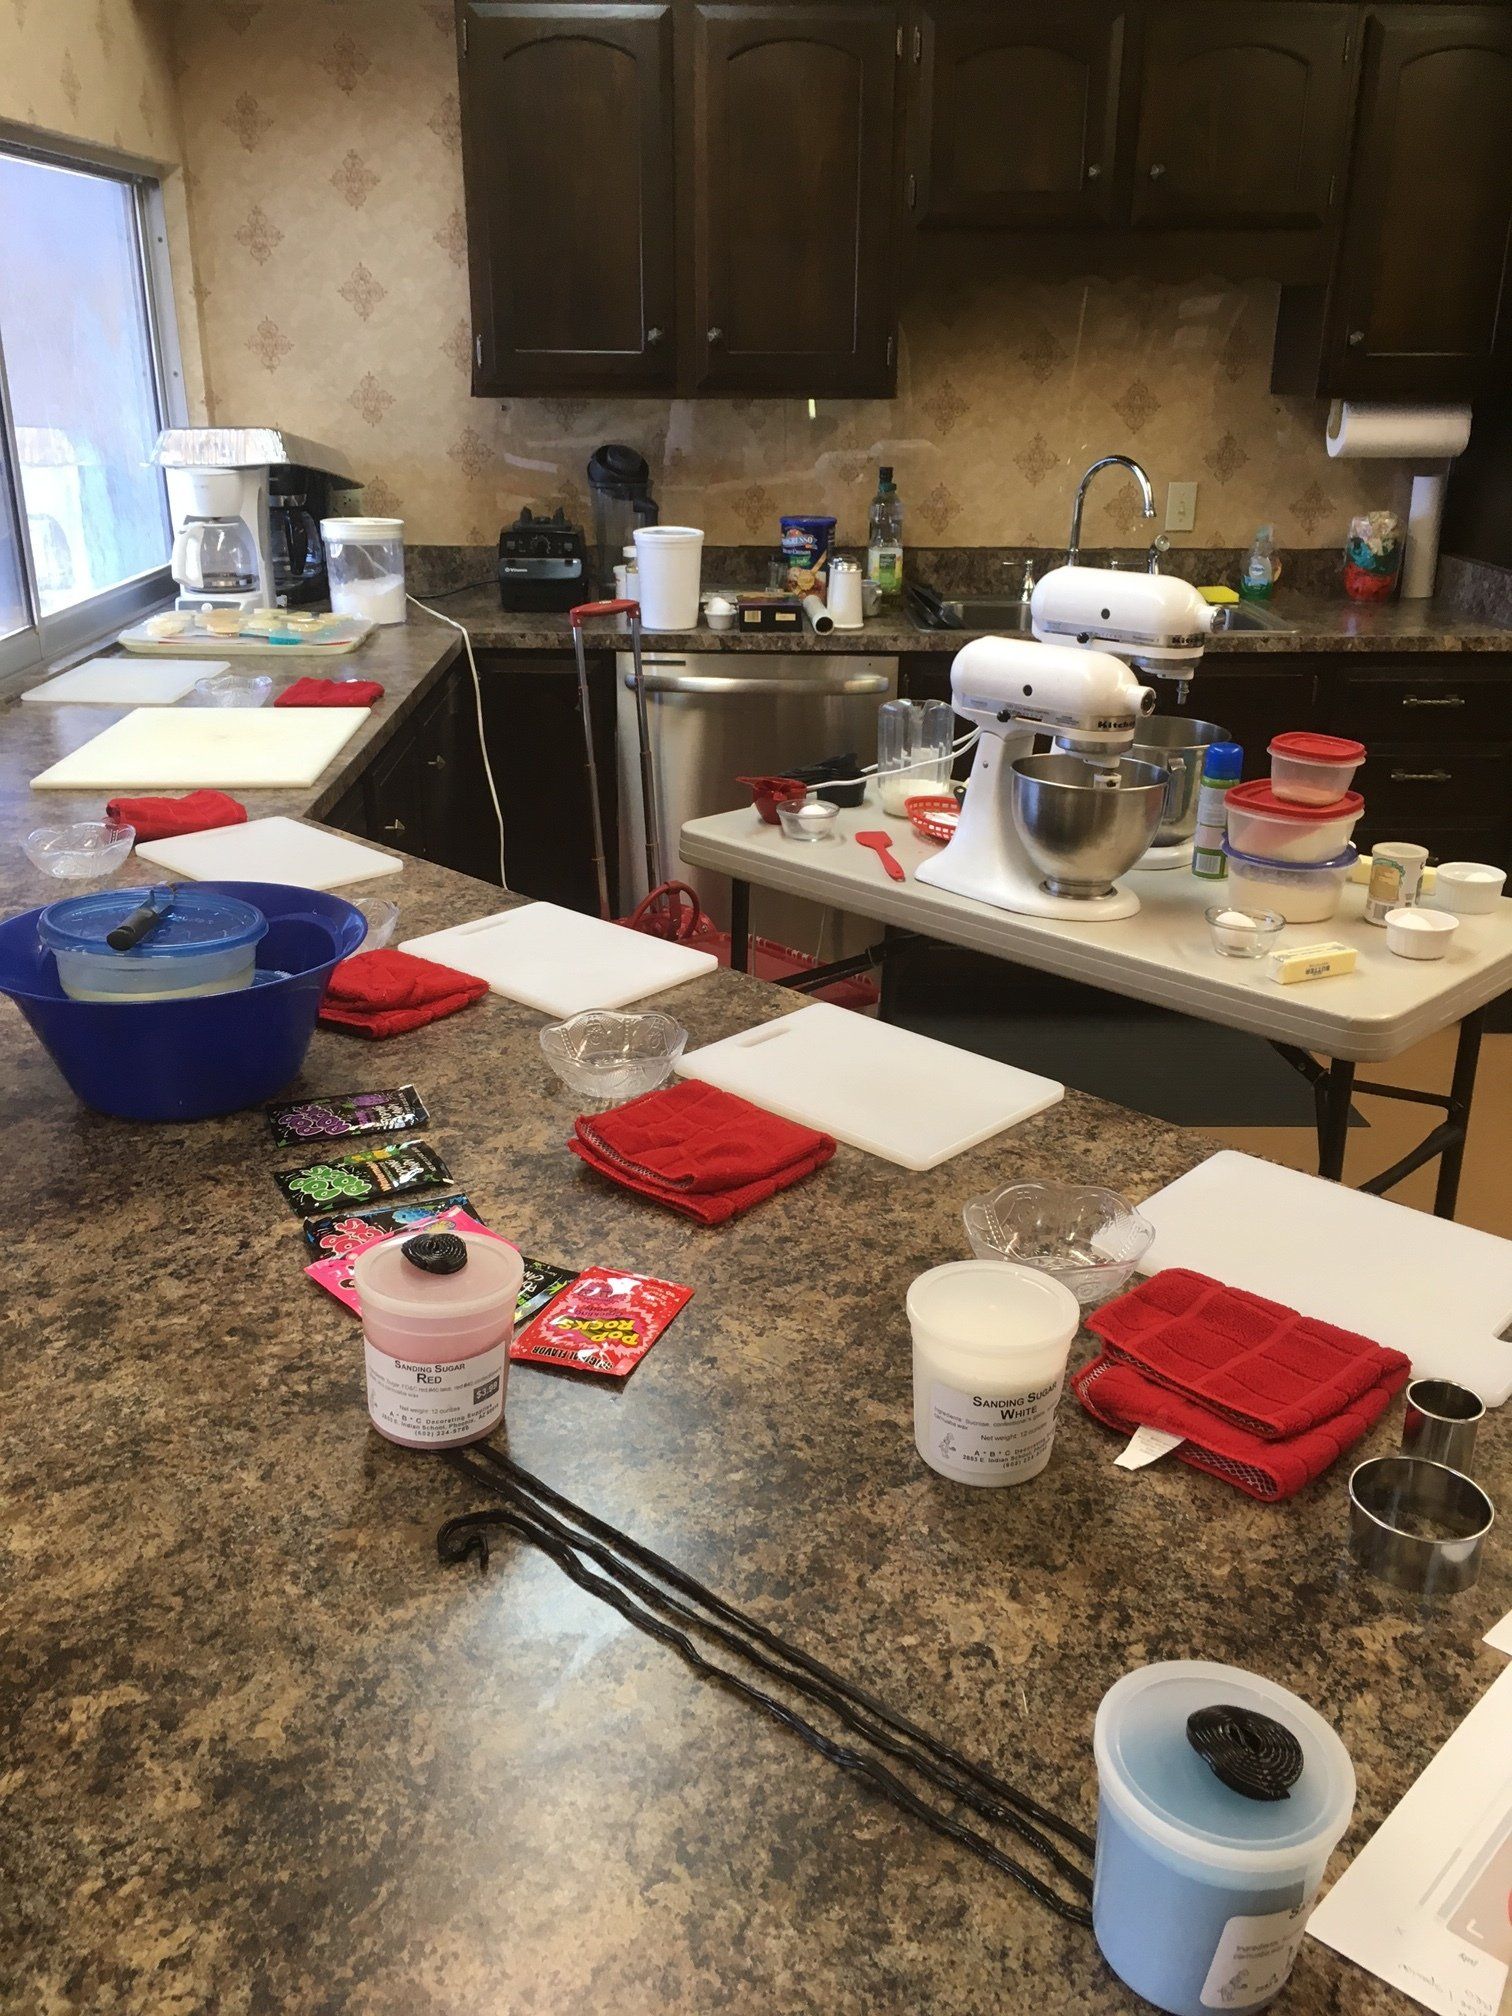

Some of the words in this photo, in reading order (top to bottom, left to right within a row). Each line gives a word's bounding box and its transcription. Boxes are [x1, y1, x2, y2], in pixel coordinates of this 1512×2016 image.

[1305, 964, 1331, 975] BUTTER
[300, 1164, 373, 1196] ROCKS
[288, 1177, 343, 1201] POP
[558, 1319, 636, 1332] ROCKS
[589, 1330, 640, 1346] POP
[532, 1346, 571, 1361] FLAVOR
[475, 1381, 498, 1400] $3.99
